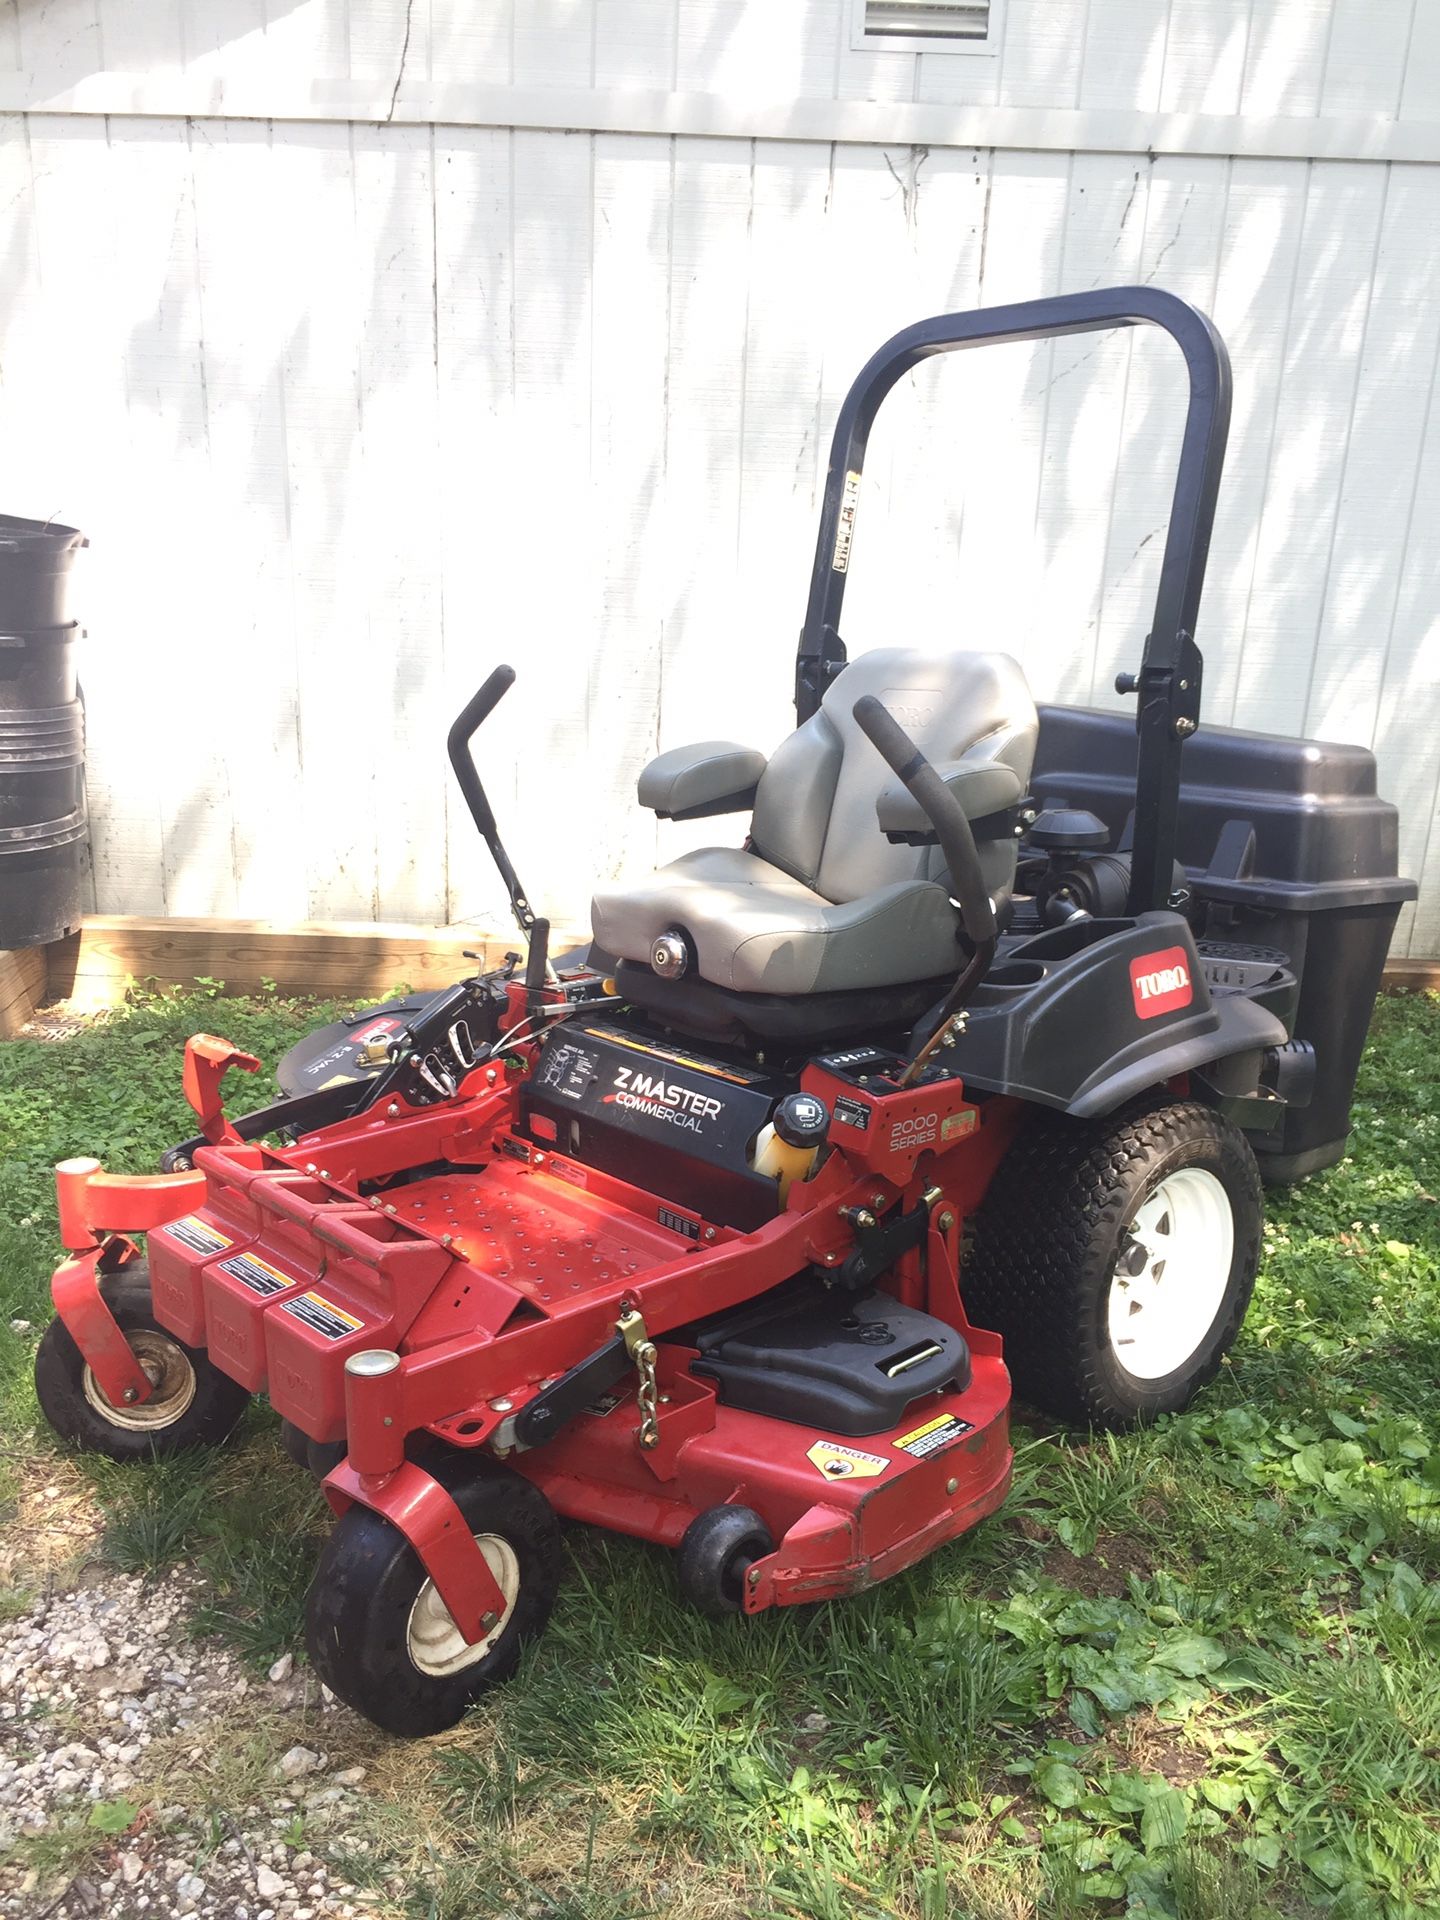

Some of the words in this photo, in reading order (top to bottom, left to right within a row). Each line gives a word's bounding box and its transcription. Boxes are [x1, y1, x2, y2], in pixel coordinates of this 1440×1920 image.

[1135, 965, 1187, 999] TORO
[613, 1066, 632, 1089] Z
[630, 1073, 722, 1120] MASTER
[615, 1091, 703, 1133] COMMERCIAL
[891, 1113, 938, 1137] 2000
[889, 1129, 937, 1152] SERIES
[821, 1443, 882, 1465] DANGER
